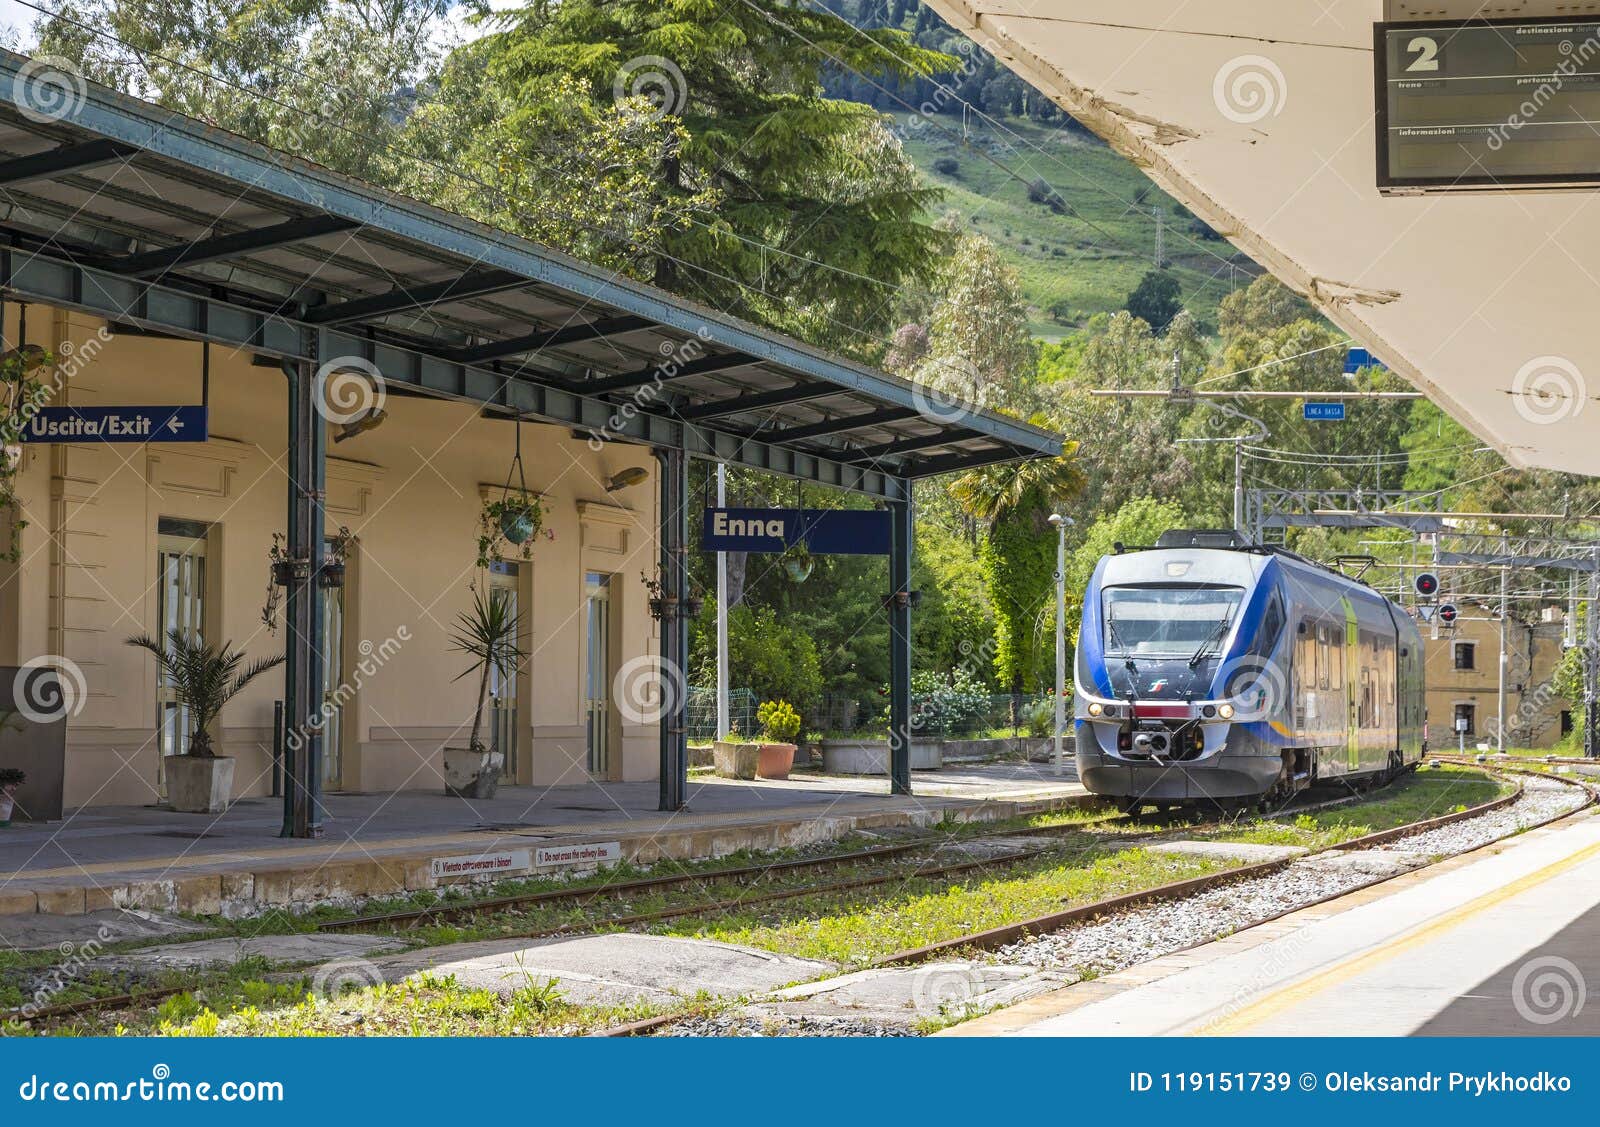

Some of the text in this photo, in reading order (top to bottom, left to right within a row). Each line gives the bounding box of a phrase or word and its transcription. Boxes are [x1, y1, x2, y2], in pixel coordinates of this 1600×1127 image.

[1516, 26, 1574, 35] destinazione
[1406, 36, 1439, 72] 2
[1516, 76, 1559, 85] partenza
[1399, 127, 1455, 136] informazioni
[31, 415, 152, 436] Uscita/Exit
[713, 512, 785, 538] Enna
[442, 861, 461, 873] Vietato
